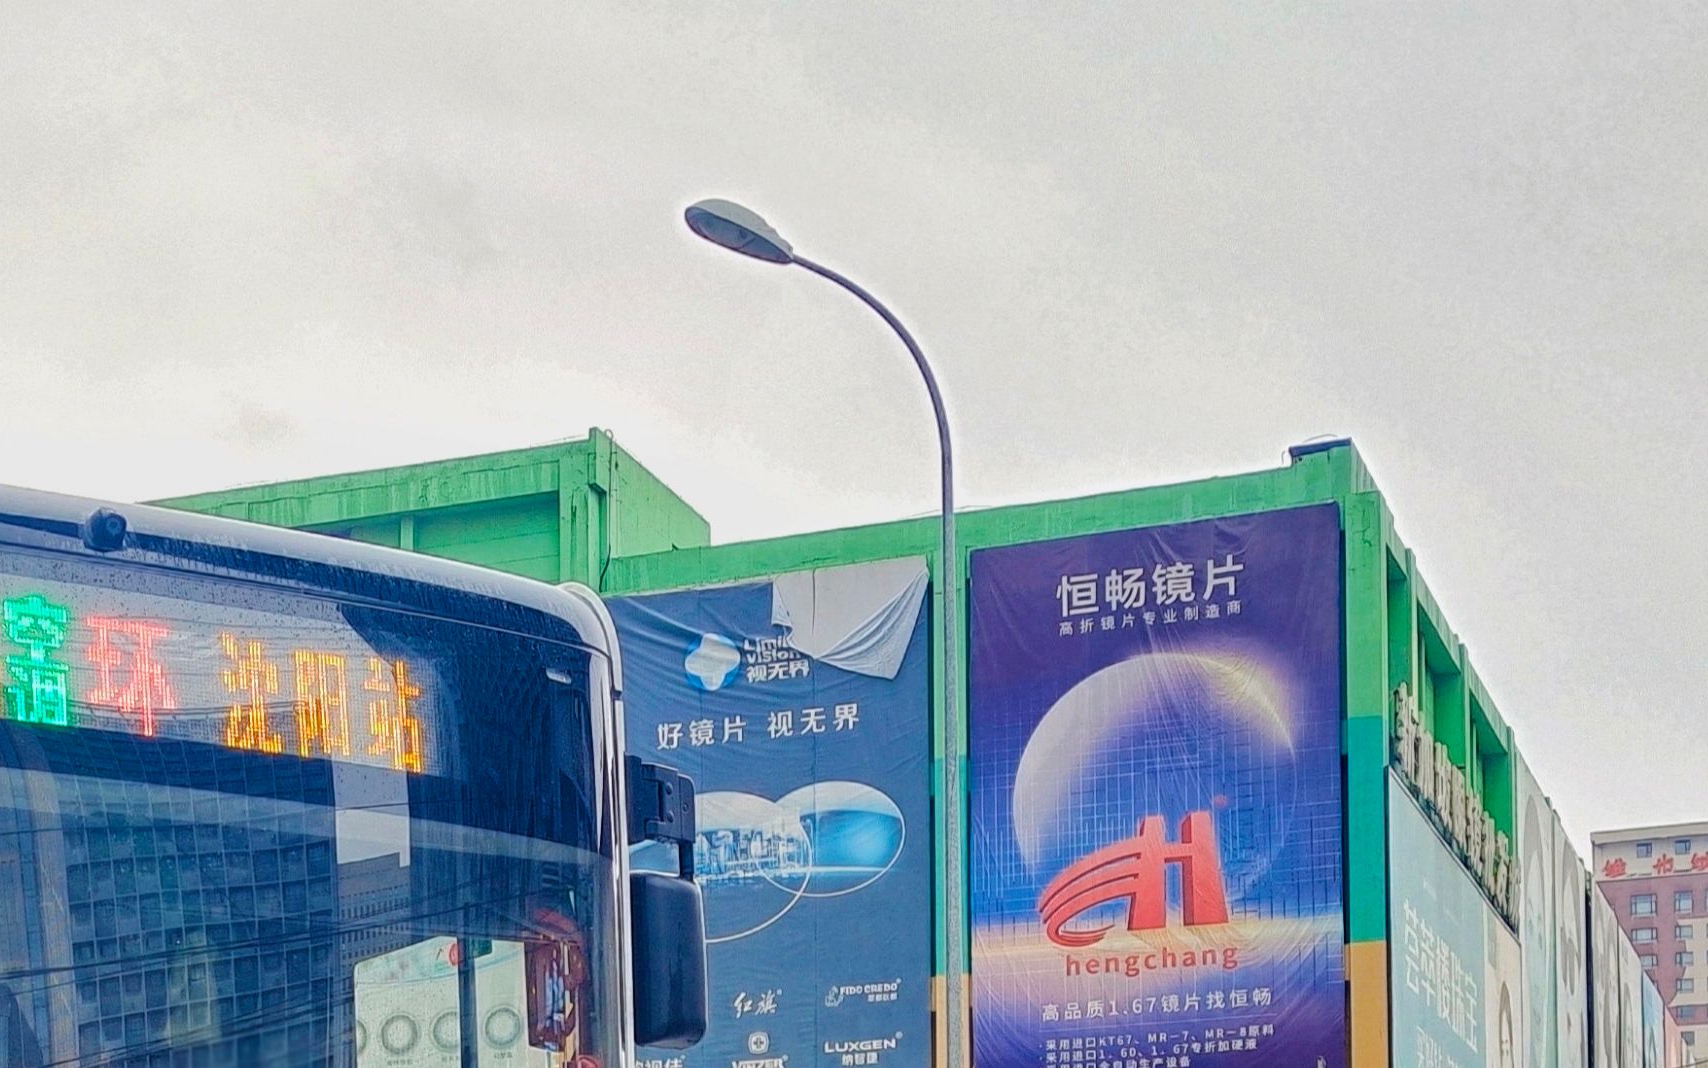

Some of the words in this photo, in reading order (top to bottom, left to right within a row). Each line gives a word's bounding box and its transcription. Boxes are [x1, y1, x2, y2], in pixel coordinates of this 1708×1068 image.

[1056, 554, 1244, 618] 恒畅镜片
[1059, 600, 1242, 637] 高折镜片专业制造商
[2, 594, 71, 727] 空调
[85, 616, 176, 738] 环
[220, 630, 423, 775] 沈阳站
[746, 659, 810, 683] 视无界
[657, 715, 747, 750] 好镜片
[767, 703, 860, 739] 视无界
[1065, 946, 1240, 979] hengchang
[824, 1038, 896, 1053] LUXGEN
